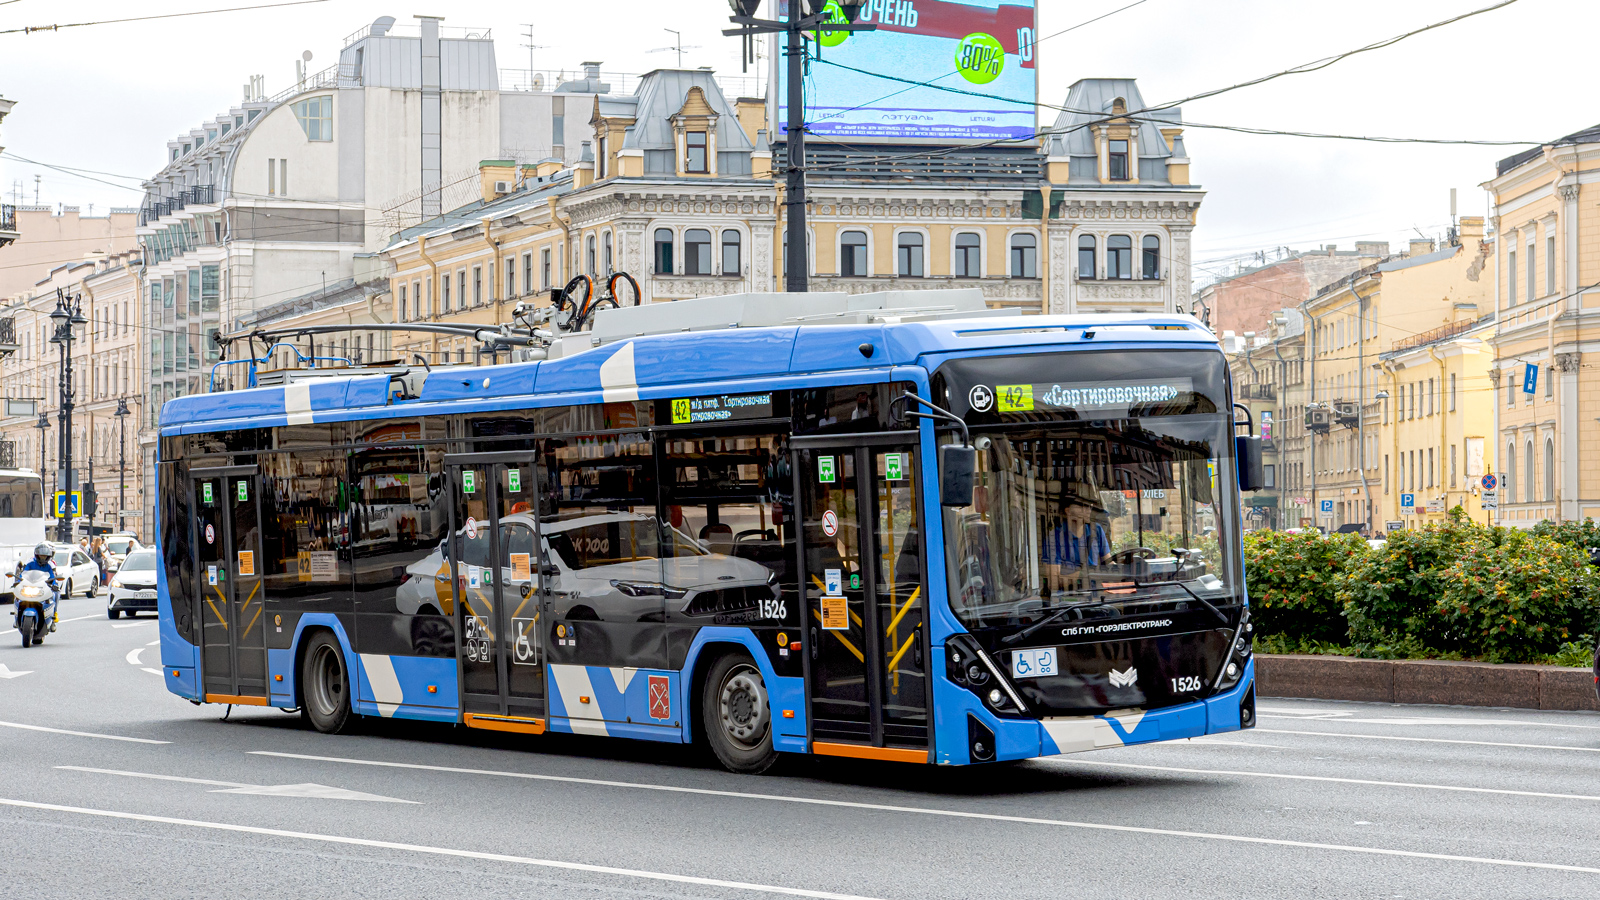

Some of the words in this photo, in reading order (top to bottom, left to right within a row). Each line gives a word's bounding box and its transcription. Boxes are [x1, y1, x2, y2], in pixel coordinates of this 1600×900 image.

[860, 0, 919, 28] ОЧЕНЬ
[961, 44, 999, 76] 80%
[1004, 386, 1025, 408] 42
[1042, 384, 1179, 408] «Сортировочная»
[674, 400, 688, 421] 42
[1143, 489, 1165, 499] ХЛЕБ
[299, 557, 310, 573] 42
[758, 599, 787, 620] 1526
[1078, 626, 1095, 634] ГУП
[1095, 619, 1173, 633] «ГОРЭЛЕКТРОТРАНС»
[1171, 675, 1201, 693] 1526
